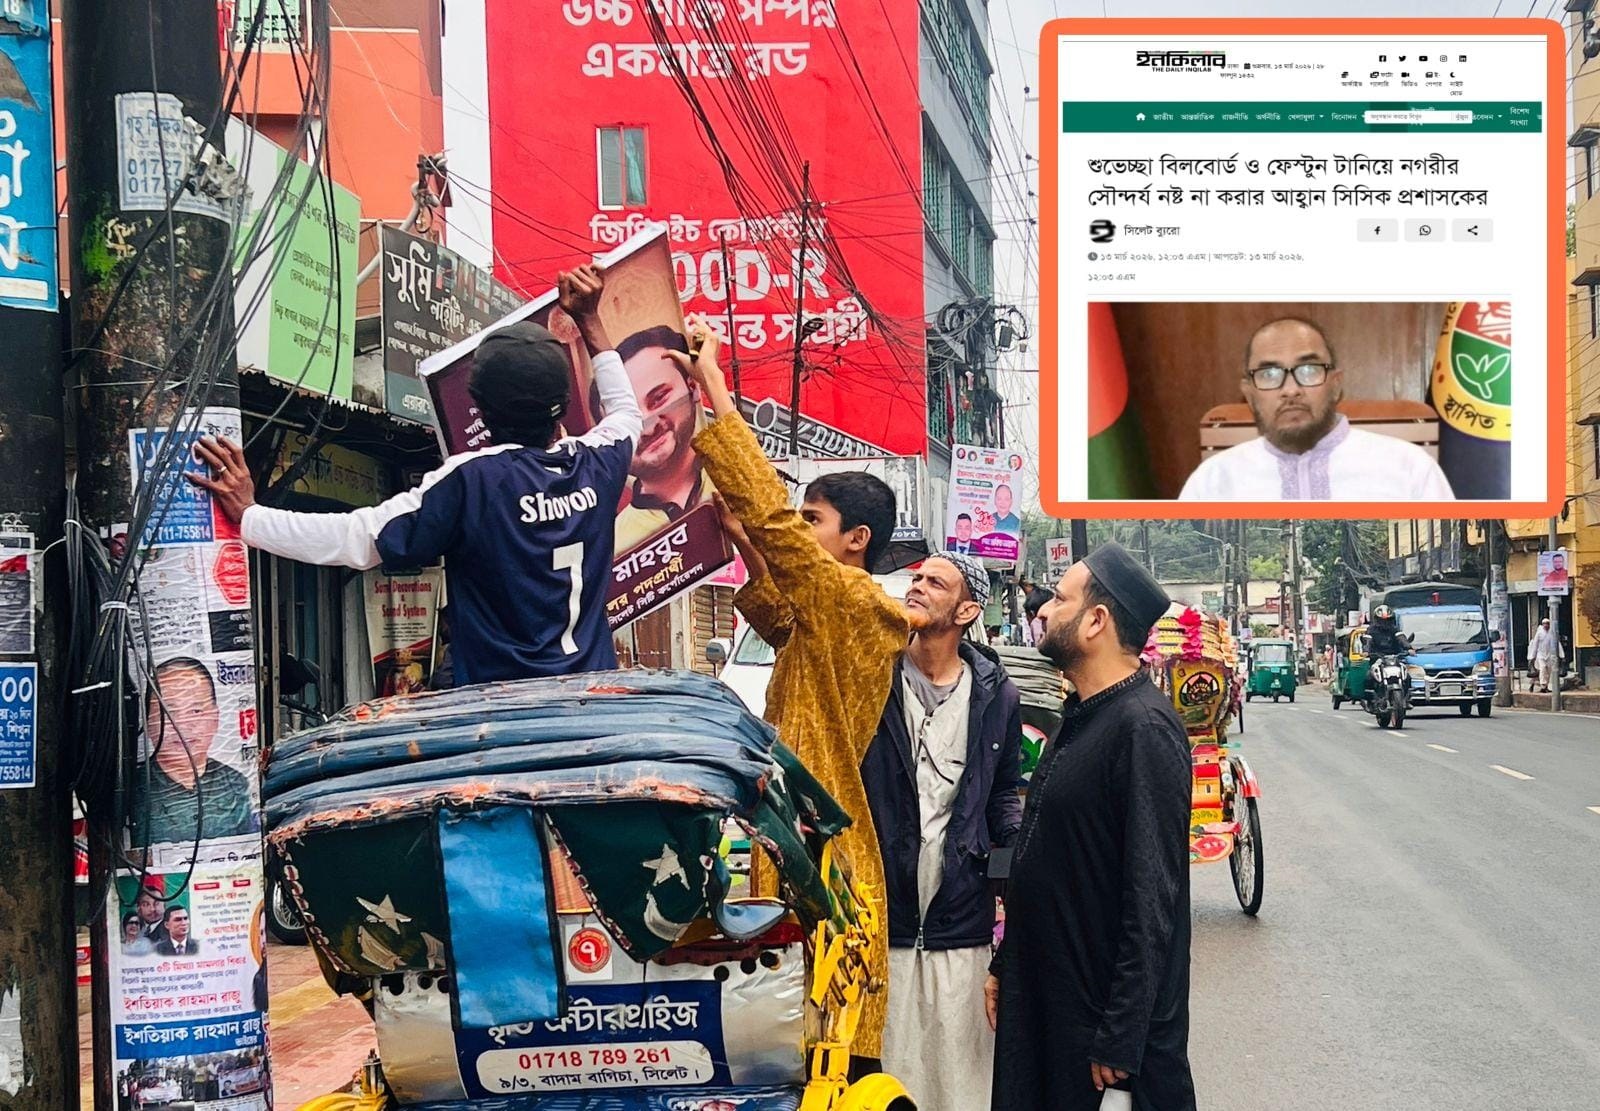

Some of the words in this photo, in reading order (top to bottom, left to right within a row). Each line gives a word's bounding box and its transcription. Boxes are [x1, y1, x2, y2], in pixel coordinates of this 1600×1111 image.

[581, 39, 735, 78] একমাত্র
[743, 42, 810, 80] রড
[519, 486, 597, 523] Shovon
[612, 522, 688, 582] মাহবুব
[633, 553, 683, 595] পদপ্রার্থী
[636, 590, 655, 610] সিটি
[657, 562, 704, 595] কর্পোরেশন
[403, 604, 427, 619] System
[552, 541, 584, 656] 7
[6, 720, 31, 741] শিখুন
[580, 941, 597, 962] ৭
[123, 994, 175, 1012] ইশতিয়াক
[178, 991, 217, 1008] রাহমান
[221, 989, 242, 1006] রাজু
[123, 1024, 189, 1046] ইশতিয়াক
[191, 1020, 239, 1041] রাহমান
[242, 1016, 262, 1036] রাজু
[519, 1050, 583, 1070] 01718
[589, 1048, 627, 1066] 789
[635, 1047, 671, 1064] 261
[499, 1075, 536, 1091] ৯/৩,
[540, 1072, 582, 1088] বাদাম
[588, 1068, 638, 1086] বাগিচা,
[642, 1065, 689, 1081] সিলেট
